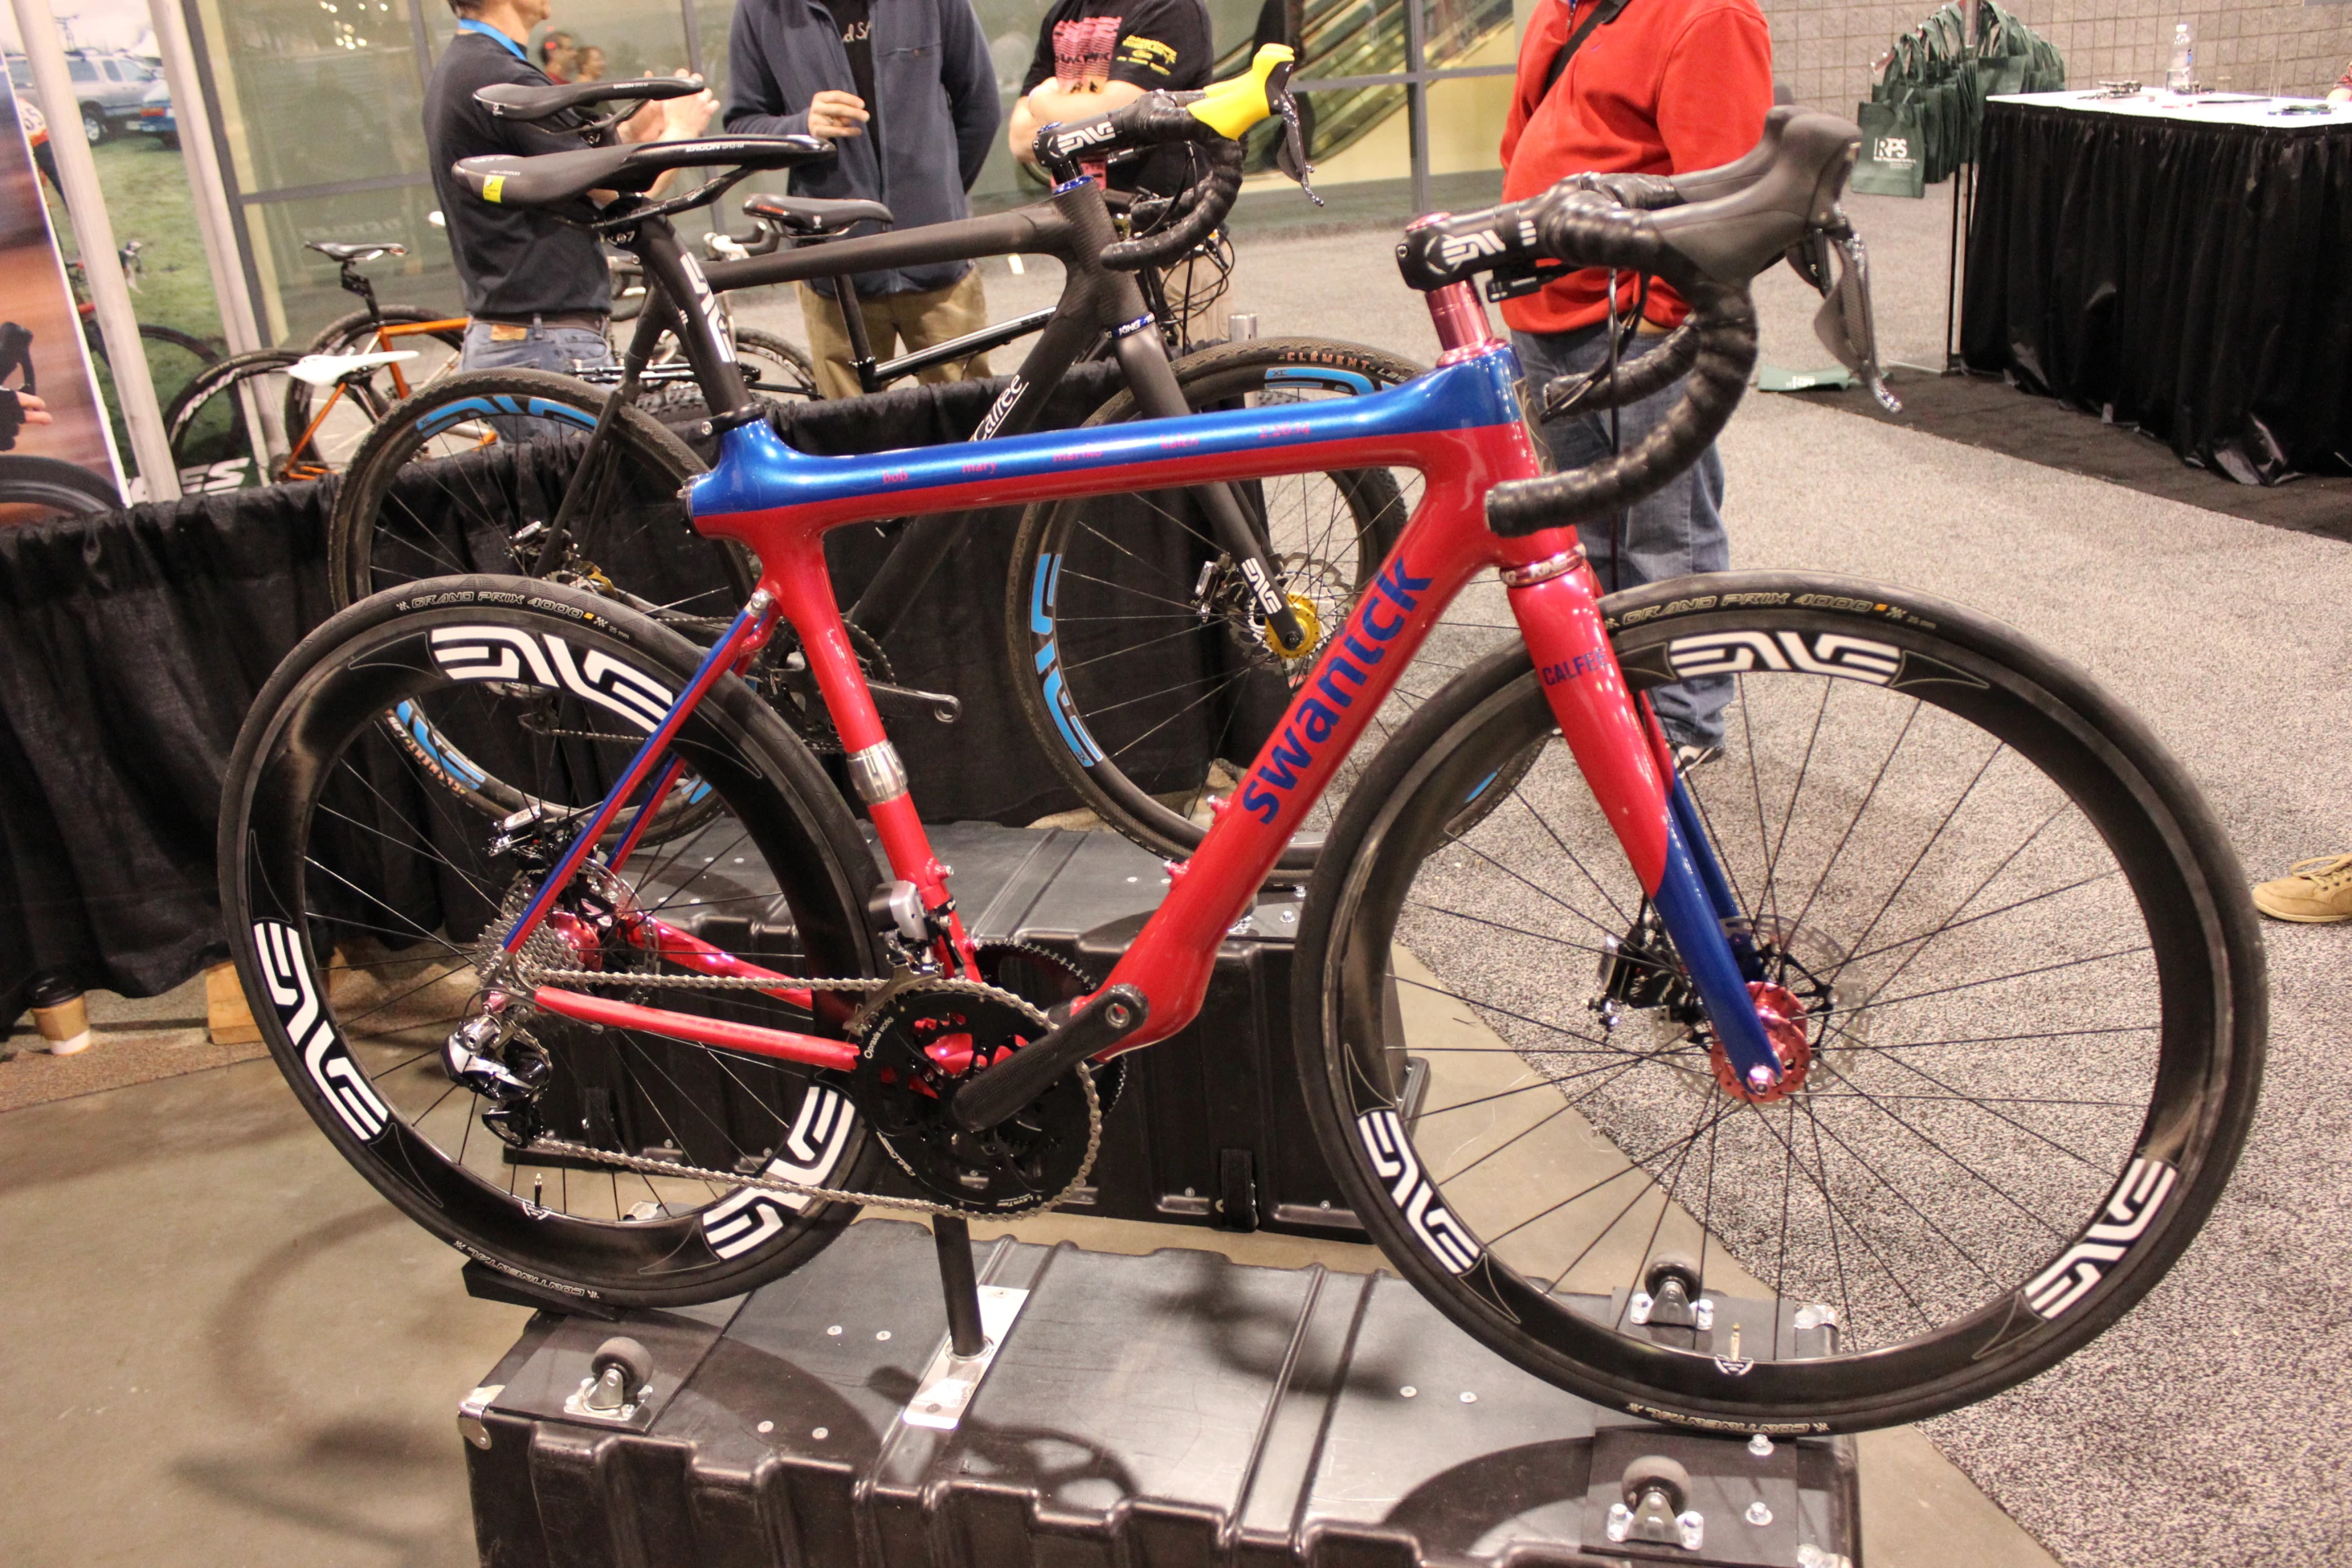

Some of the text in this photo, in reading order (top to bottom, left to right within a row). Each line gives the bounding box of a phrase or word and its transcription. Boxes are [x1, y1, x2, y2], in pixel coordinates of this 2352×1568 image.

[686, 142, 721, 154] ERGON
[1058, 121, 1116, 154] ENVE
[1879, 137, 1908, 158] RPS
[1119, 318, 1142, 336] KING
[972, 373, 1022, 443] Calfee
[882, 470, 909, 483] bob
[962, 461, 997, 475] mary
[1241, 557, 1283, 615] ENVE
[1622, 595, 1717, 625] GRAND
[1720, 592, 1791, 607] PRIX
[1920, 621, 1936, 629] mm
[411, 591, 474, 609] GRAND
[477, 591, 525, 605] PRIX
[618, 631, 630, 640] mm
[431, 626, 673, 733] ENVE
[1542, 647, 1607, 686] CALFEE
[1668, 630, 1900, 685] ENVE
[253, 922, 389, 1140] ENVE
[703, 1086, 856, 1260] ENVE
[1357, 1111, 1481, 1274] ENVE
[2025, 1158, 2177, 1320] ENVE
[467, 1246, 586, 1297] CONTINENTAL
[1645, 1406, 1811, 1433] CONTINENTAL
